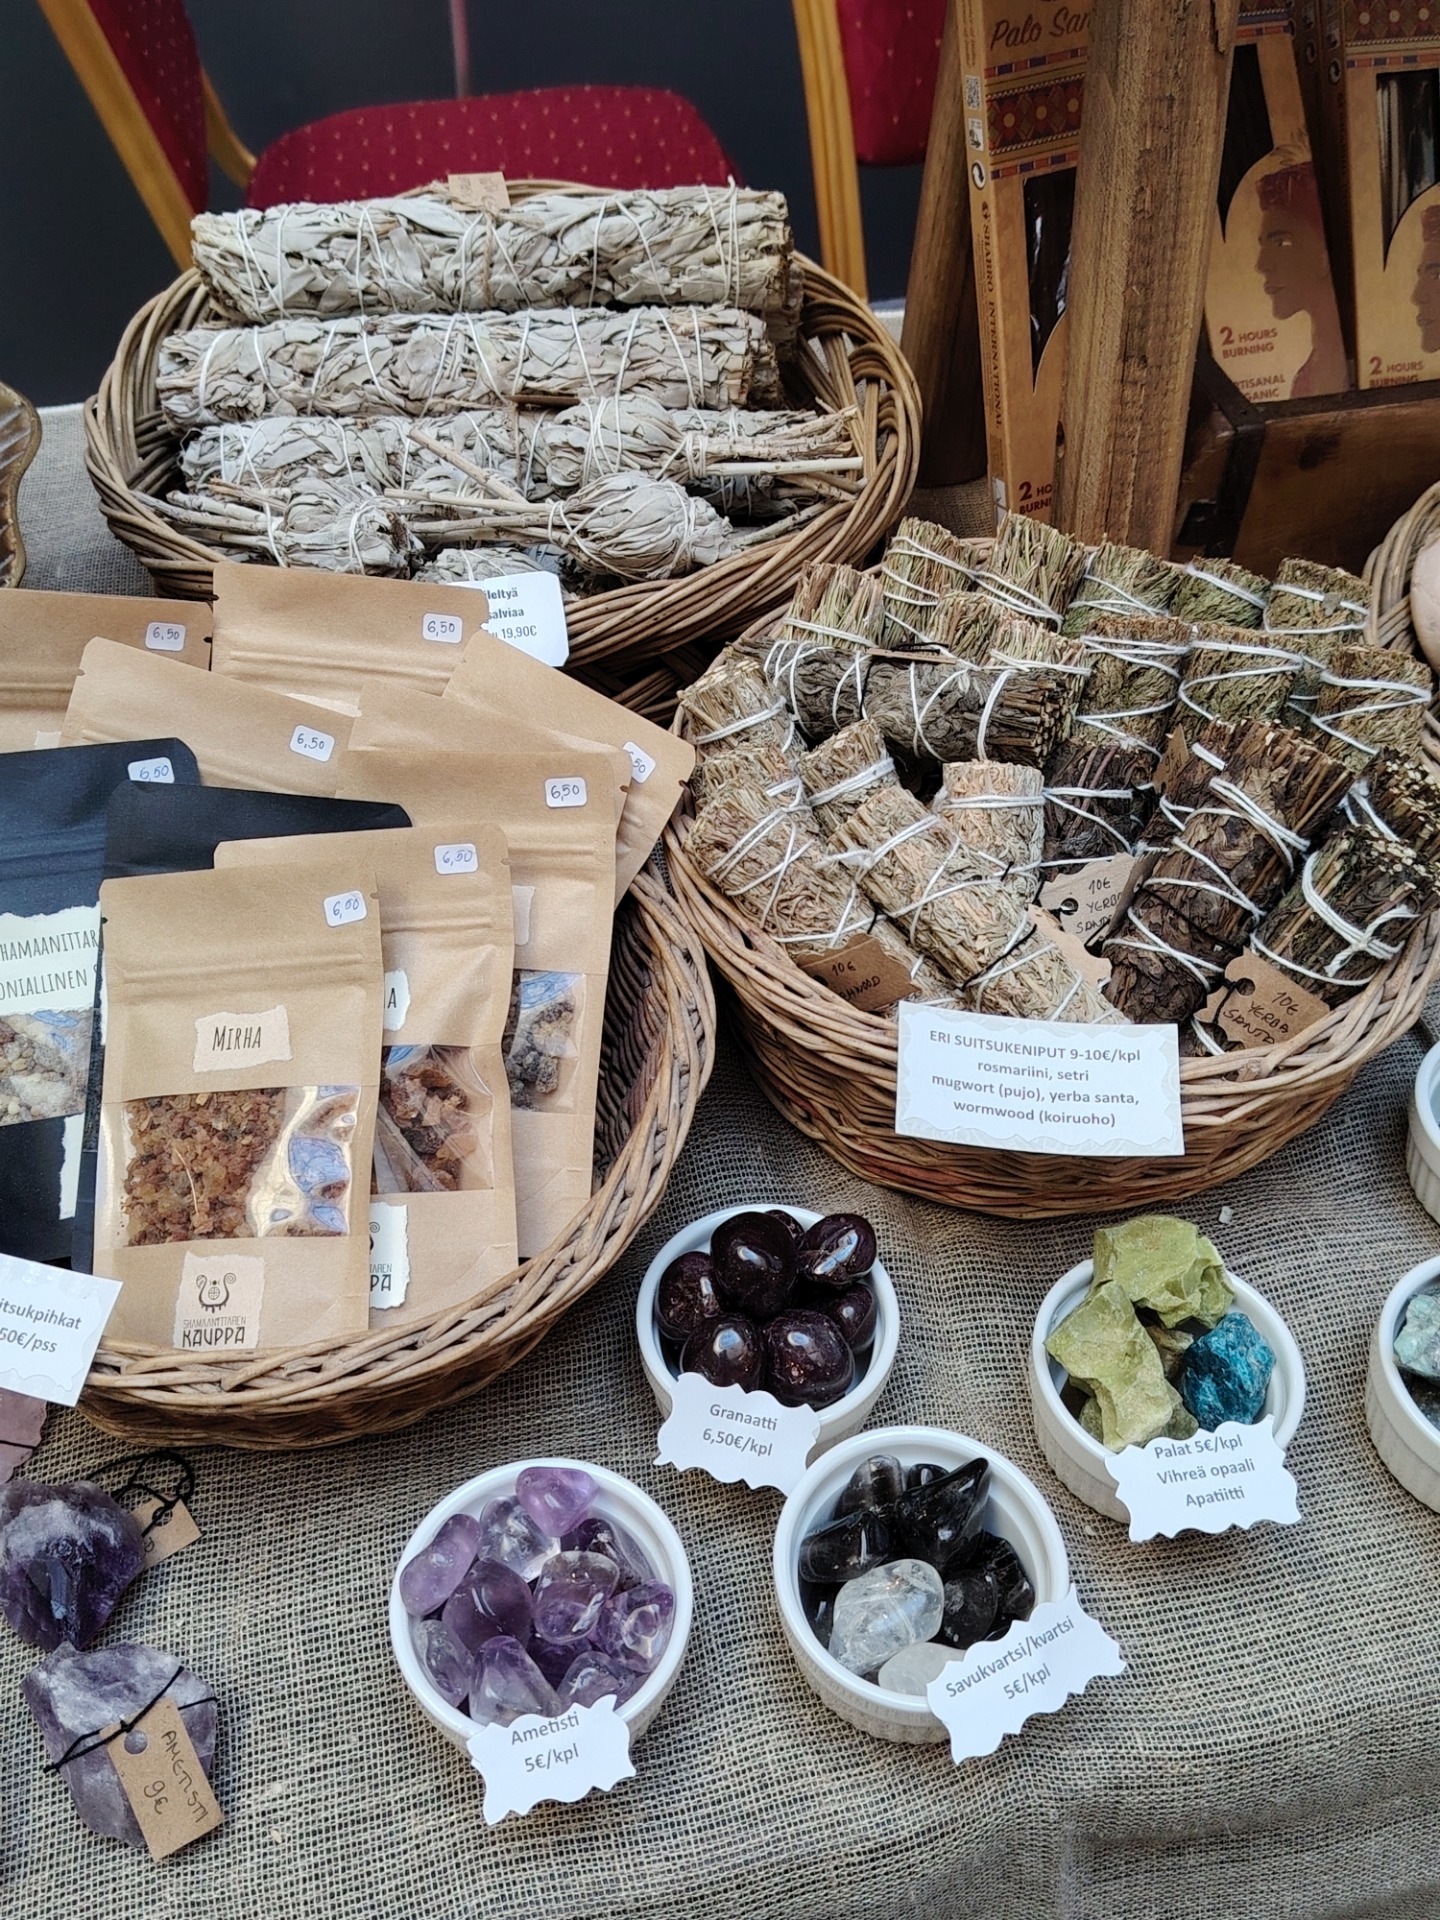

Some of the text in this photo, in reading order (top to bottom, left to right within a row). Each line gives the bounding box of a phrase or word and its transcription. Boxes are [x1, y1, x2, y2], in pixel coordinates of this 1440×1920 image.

[990, 14, 1042, 50] Palo
[1220, 326, 1278, 346] 2 HOURS
[1222, 342, 1275, 359] BURNING
[989, 301, 1002, 429] INTERNATIONAL
[1369, 356, 1424, 375] 2 HOURS
[1019, 481, 1033, 501] 2
[152, 626, 180, 641] 6,50
[427, 620, 456, 637] 6,50
[501, 625, 538, 639] 19,90€
[297, 732, 325, 750] 6,50
[550, 783, 580, 802] 6,50
[832, 960, 857, 976] 10€
[1271, 991, 1300, 1016] 10€
[1222, 1008, 1276, 1045] SANTA
[1247, 1000, 1289, 1034] YERBA
[212, 1025, 262, 1052] MIRHA
[929, 1030, 1141, 1063] ERI SUITSUKENIPUT 9-10€/kpl
[977, 1061, 1089, 1081] rosmariini, setri
[931, 1075, 1140, 1106] mugwort (pujo), yerba santa,
[953, 1100, 1116, 1128] wormwood (koiruoho)
[370, 1273, 392, 1292] PA
[182, 1326, 246, 1348] KAUPPA
[709, 1403, 778, 1431] Granaatti
[702, 1428, 773, 1457] 6,50€/kpl
[1154, 1434, 1243, 1459] Palat 5€/kpl
[1156, 1458, 1256, 1485] Vihreä opaali
[1185, 1485, 1246, 1508] Apatiitti
[945, 1615, 1075, 1698] Savukvartsi/kvartsi
[1003, 1662, 1052, 1700] 5€/kpl
[511, 1711, 580, 1746] Ametisti
[524, 1742, 579, 1773] 5€/kpl
[143, 1780, 169, 1815] 9€
